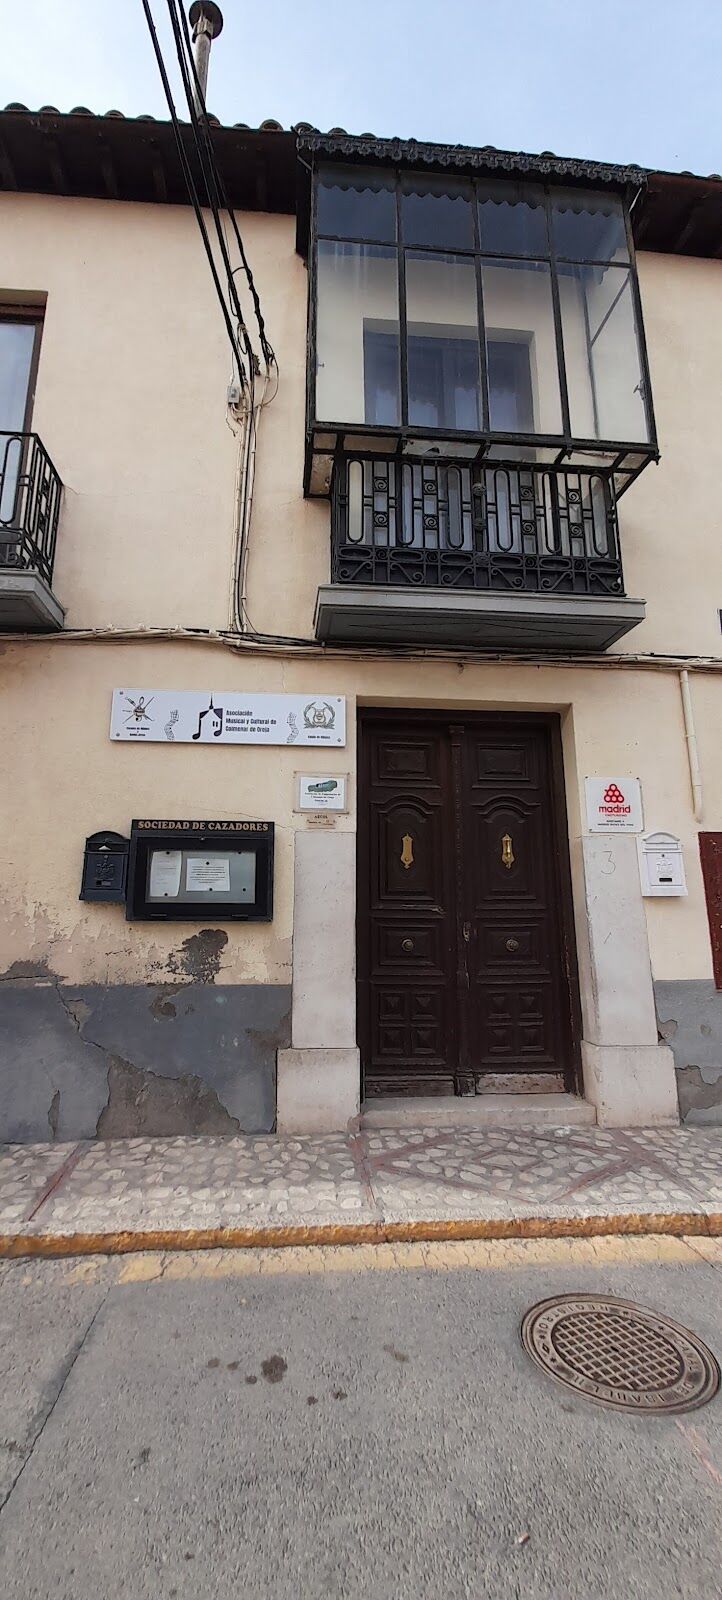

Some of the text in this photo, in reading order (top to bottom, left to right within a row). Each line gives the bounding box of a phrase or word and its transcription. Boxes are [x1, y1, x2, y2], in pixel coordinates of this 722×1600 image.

[226, 709, 253, 717] Asociación
[598, 804, 631, 814] madrid
[138, 820, 269, 831] SOCIEDAD DE CAZADORES
[600, 850, 617, 875] 3
